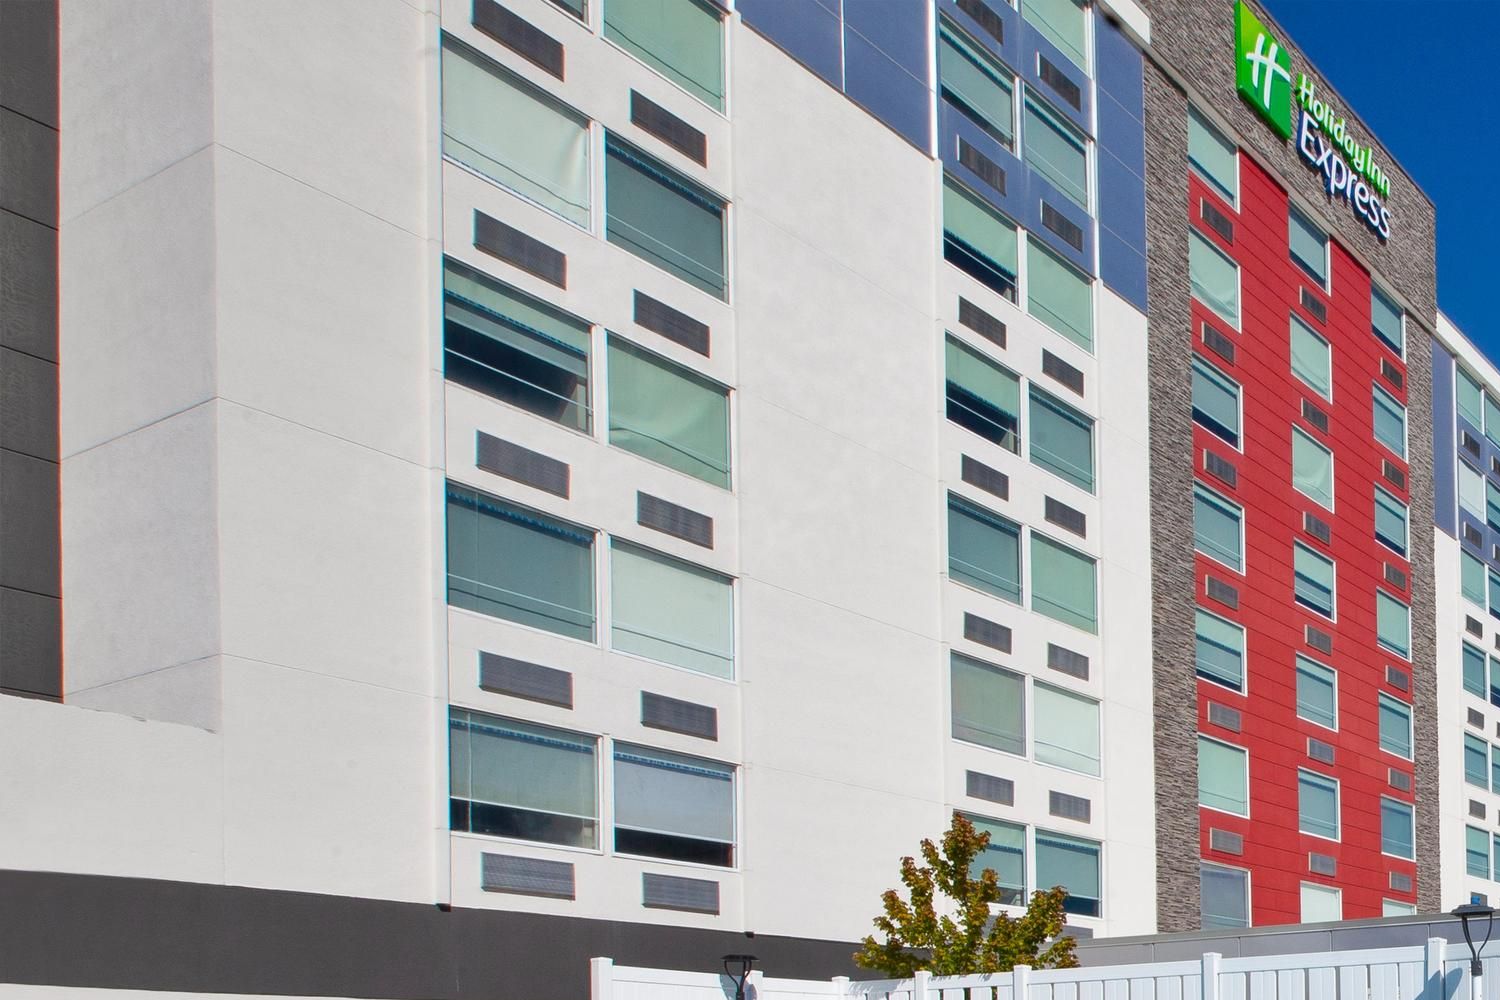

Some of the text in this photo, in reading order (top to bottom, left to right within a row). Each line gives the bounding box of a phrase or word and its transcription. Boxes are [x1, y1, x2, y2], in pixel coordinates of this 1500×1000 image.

[1298, 73, 1391, 197] Holiday Inn
[1299, 110, 1391, 239] Express
